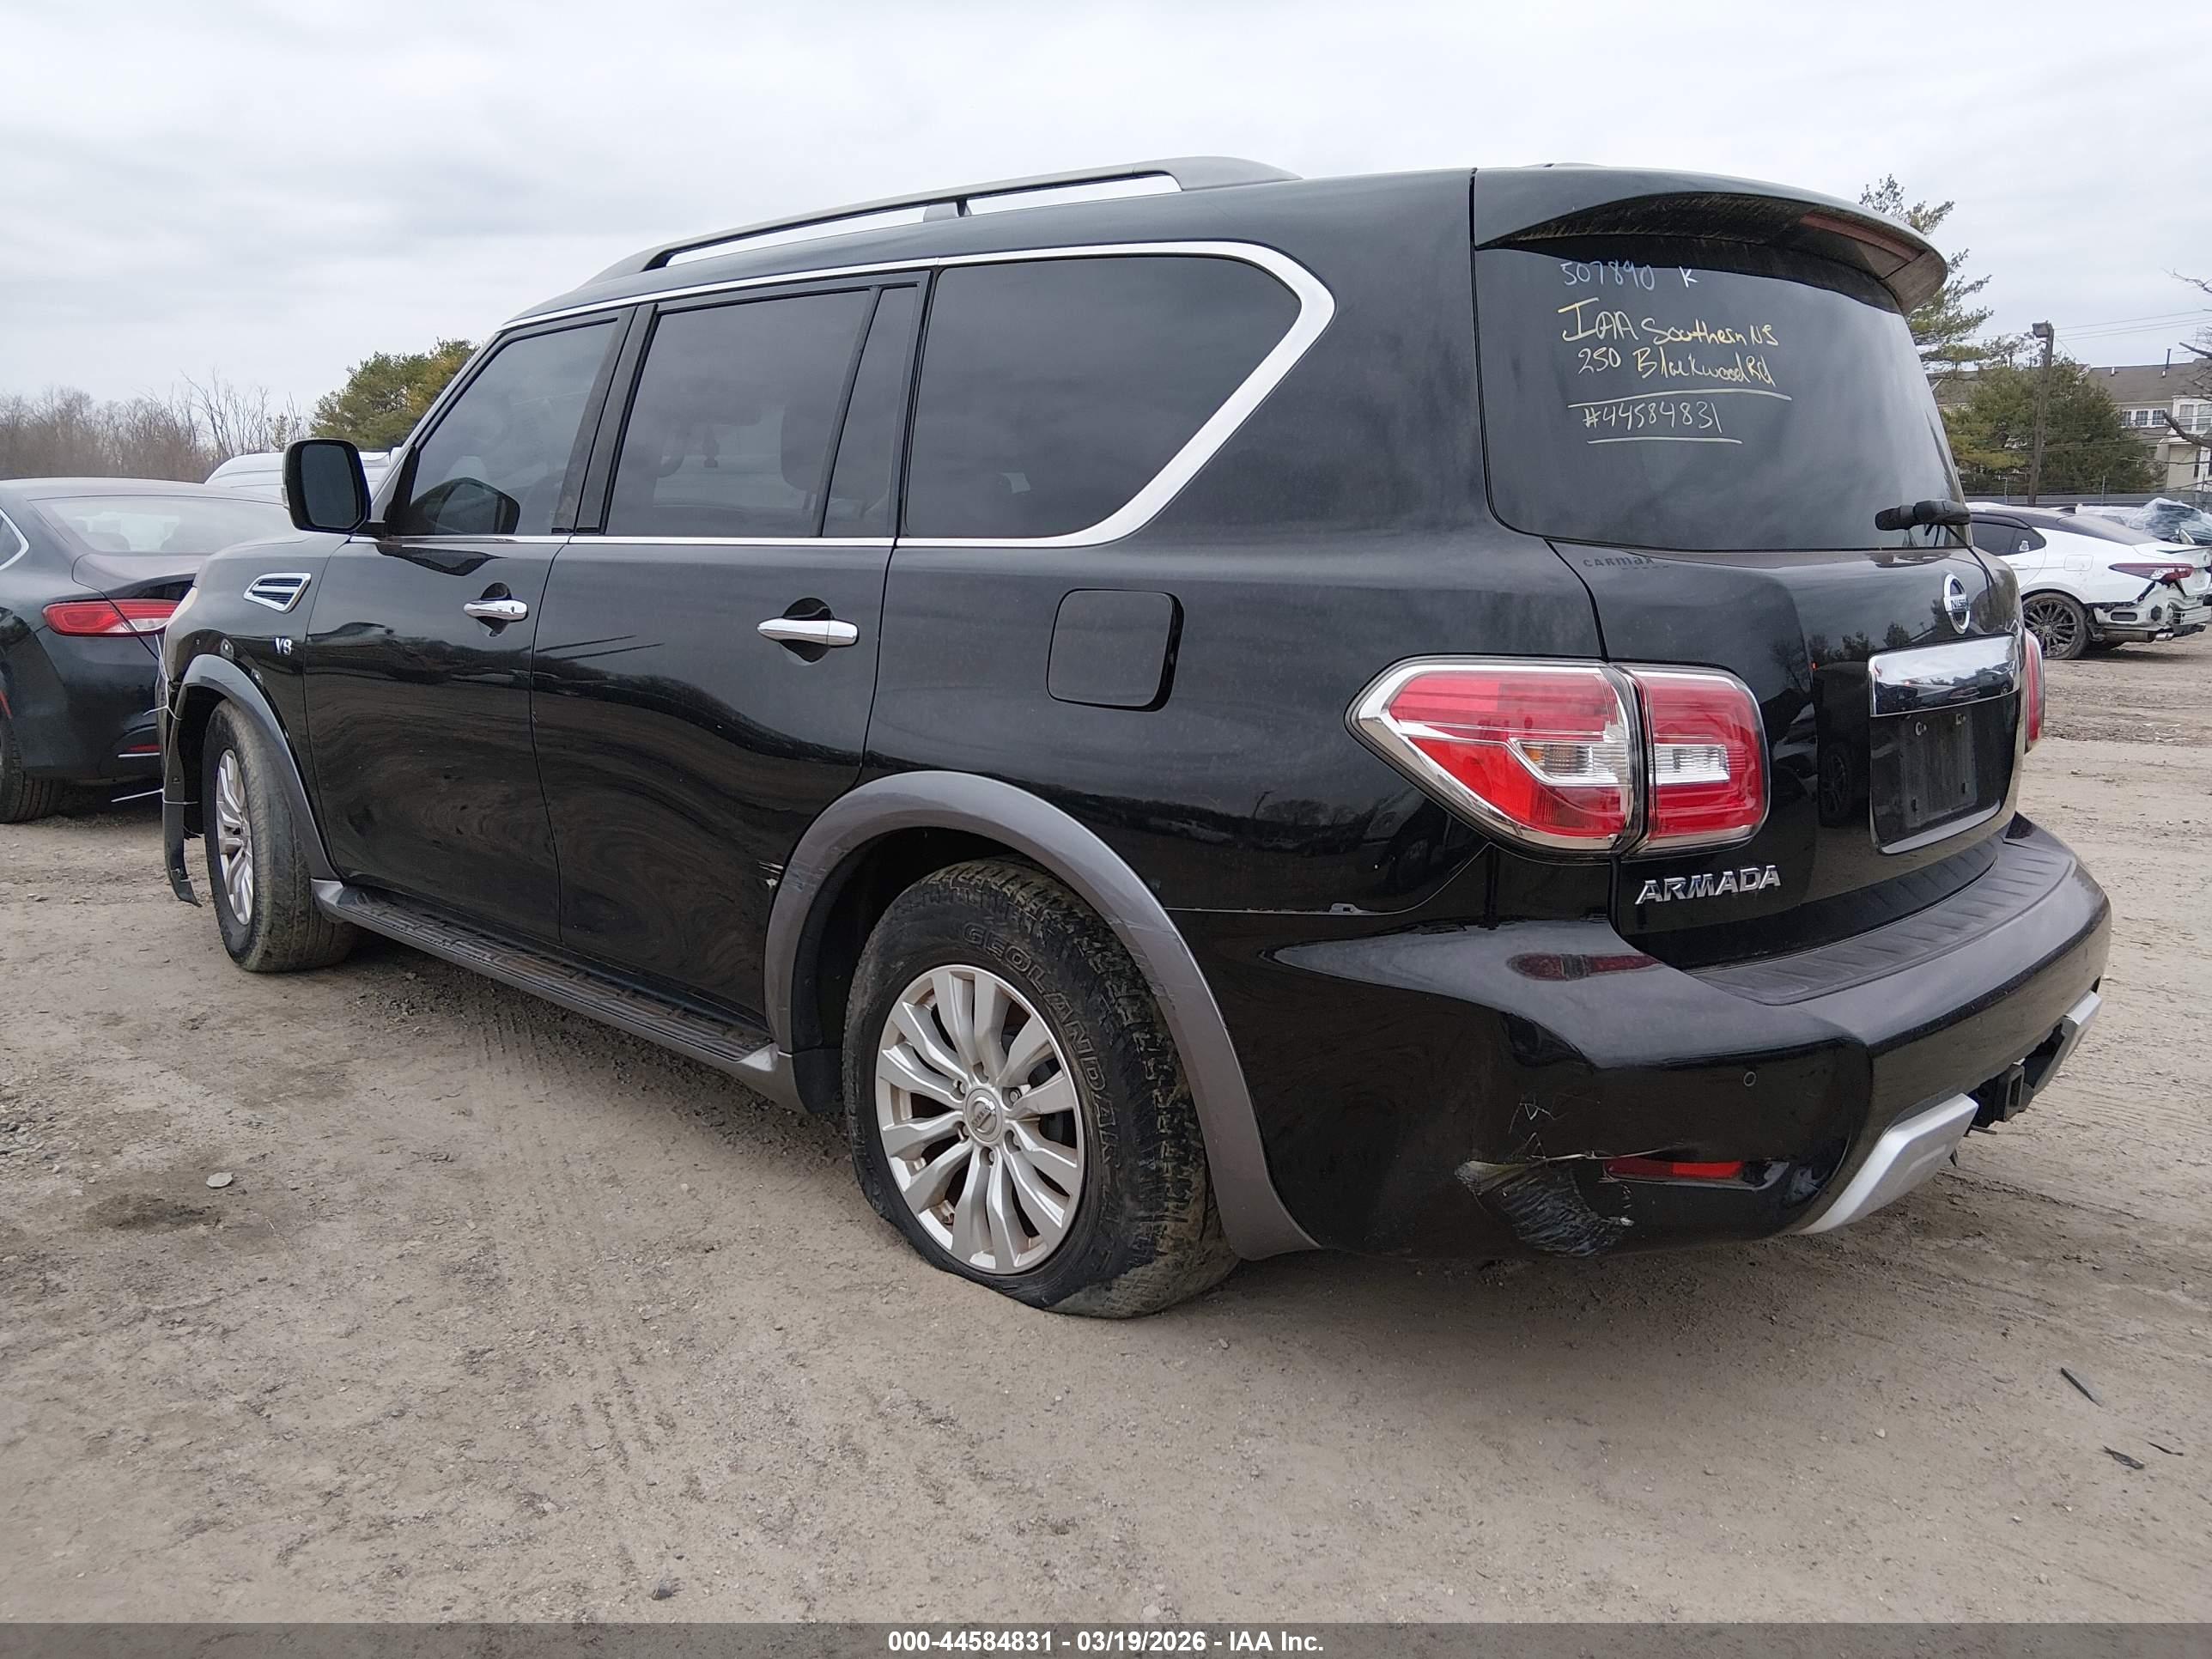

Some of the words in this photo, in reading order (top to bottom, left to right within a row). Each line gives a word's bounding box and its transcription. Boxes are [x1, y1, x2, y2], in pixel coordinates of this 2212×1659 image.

[1560, 259, 1655, 289] 507890
[1679, 265, 1698, 288] K
[1558, 297, 1638, 341] IAA
[1641, 318, 1747, 345] Southern
[1578, 347, 1621, 374] 250
[1632, 346, 1751, 383] Blackwood
[1746, 356, 1777, 386] Rd
[1583, 401, 1723, 433] #44584831
[276, 637, 293, 655] V8
[1635, 865, 1782, 904] ARMADA
